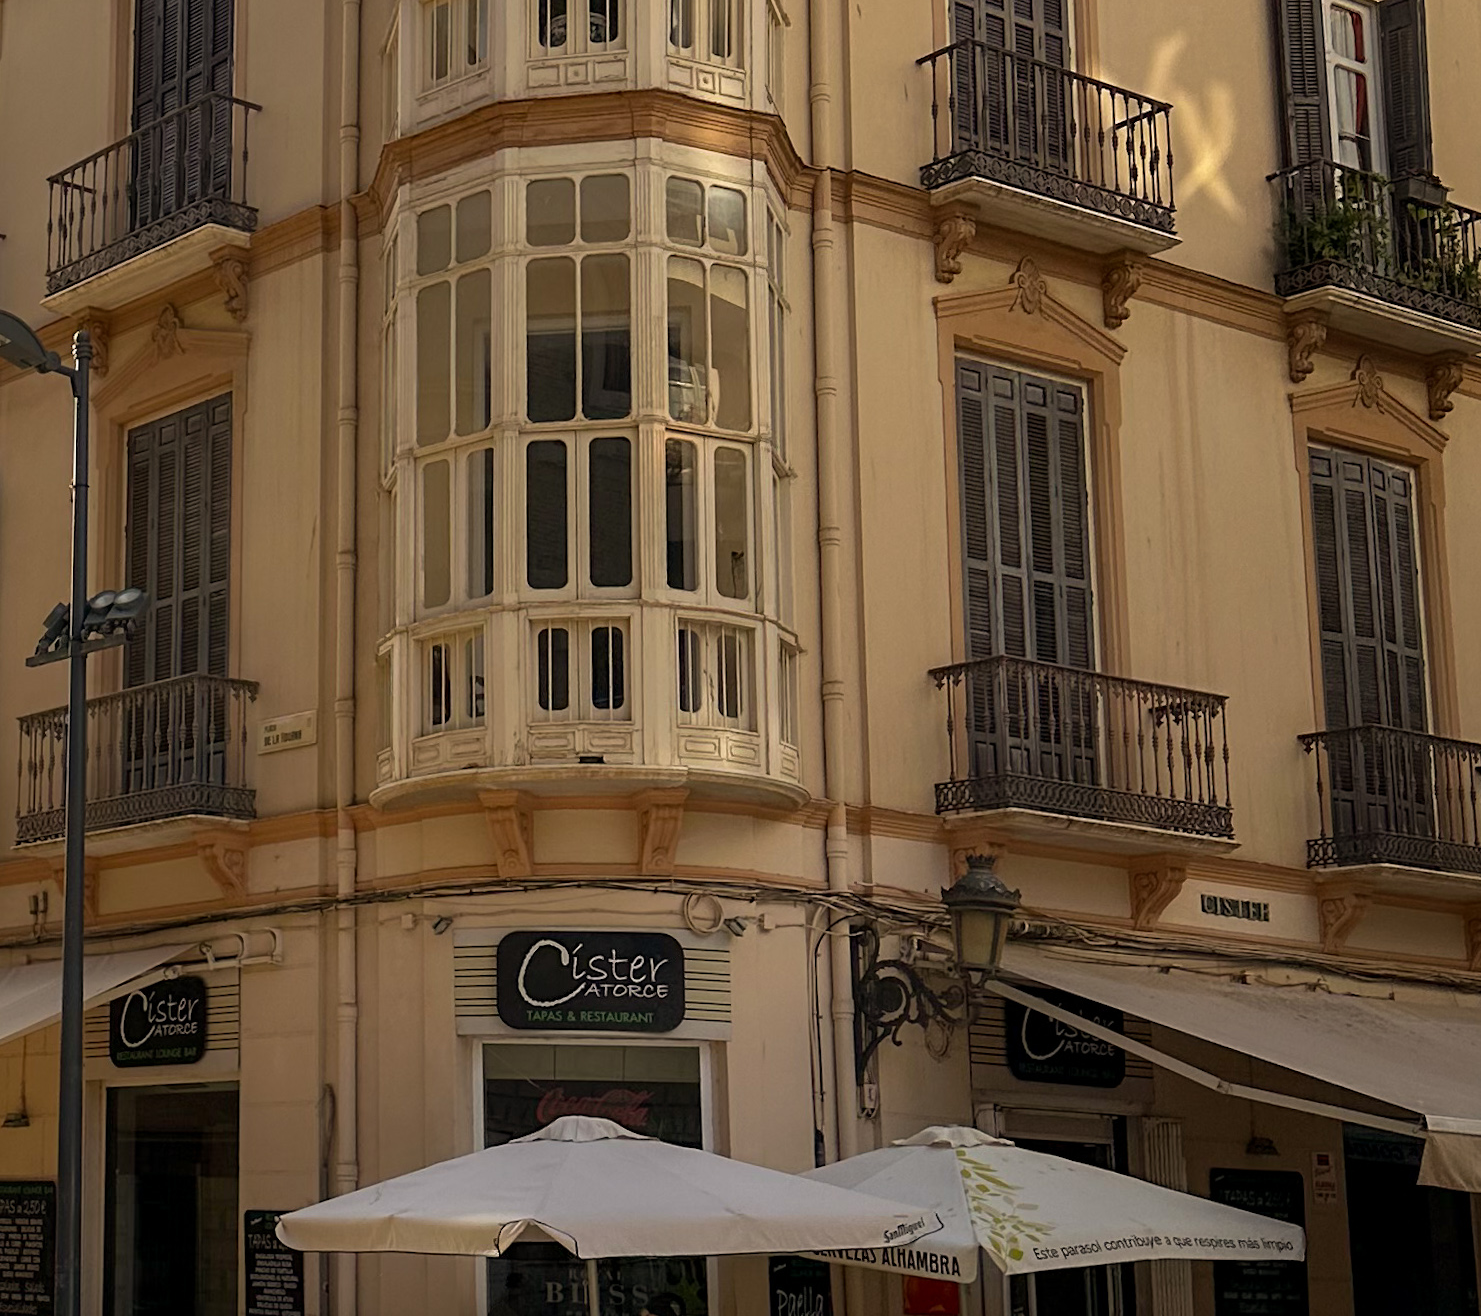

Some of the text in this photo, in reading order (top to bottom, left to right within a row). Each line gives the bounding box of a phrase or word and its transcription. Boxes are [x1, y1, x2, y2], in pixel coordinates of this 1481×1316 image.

[526, 1010, 656, 1023] TAPAS & RESTAURANT
[1033, 1234, 1294, 1261] Este parasol contribuye a que respires más limpio
[882, 1247, 962, 1277] ALHAMBRA
[545, 1281, 650, 1306] BLSS
